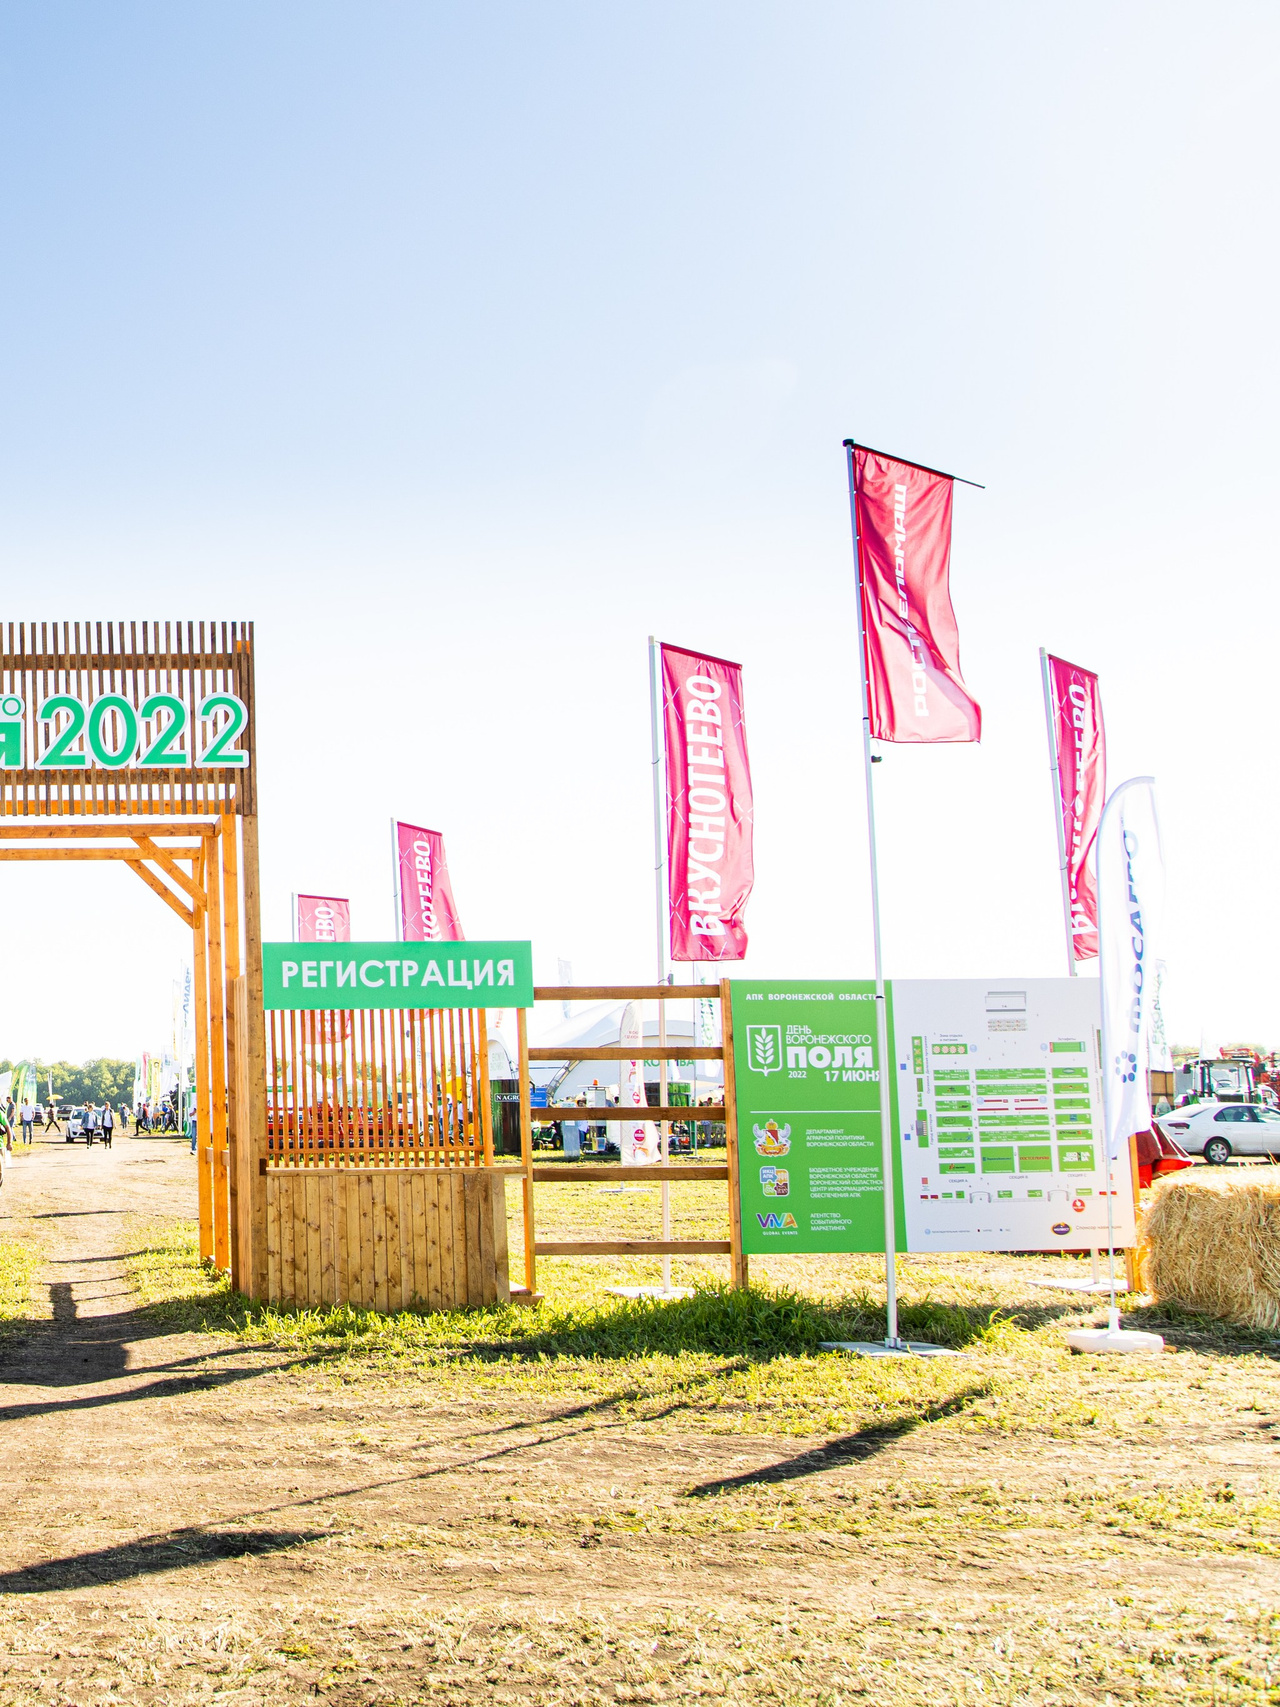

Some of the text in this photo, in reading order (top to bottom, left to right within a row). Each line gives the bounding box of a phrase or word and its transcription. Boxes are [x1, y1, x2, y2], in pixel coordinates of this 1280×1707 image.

[39, 695, 248, 767] 2022
[685, 675, 727, 936] ВКУСНОТЕЕВО
[281, 959, 515, 990] РЕГИСТРАЦИЯ
[746, 993, 764, 1001] АПК
[768, 992, 834, 1001] ВОРОНЕЖСКОЙ
[786, 1025, 812, 1035] ДЕНЬ
[786, 1034, 871, 1045] ВОРОНЕЖСКОГО
[786, 1046, 874, 1069] ПОЛЯ
[788, 1071, 807, 1079] 2022
[824, 1070, 840, 1082] 17
